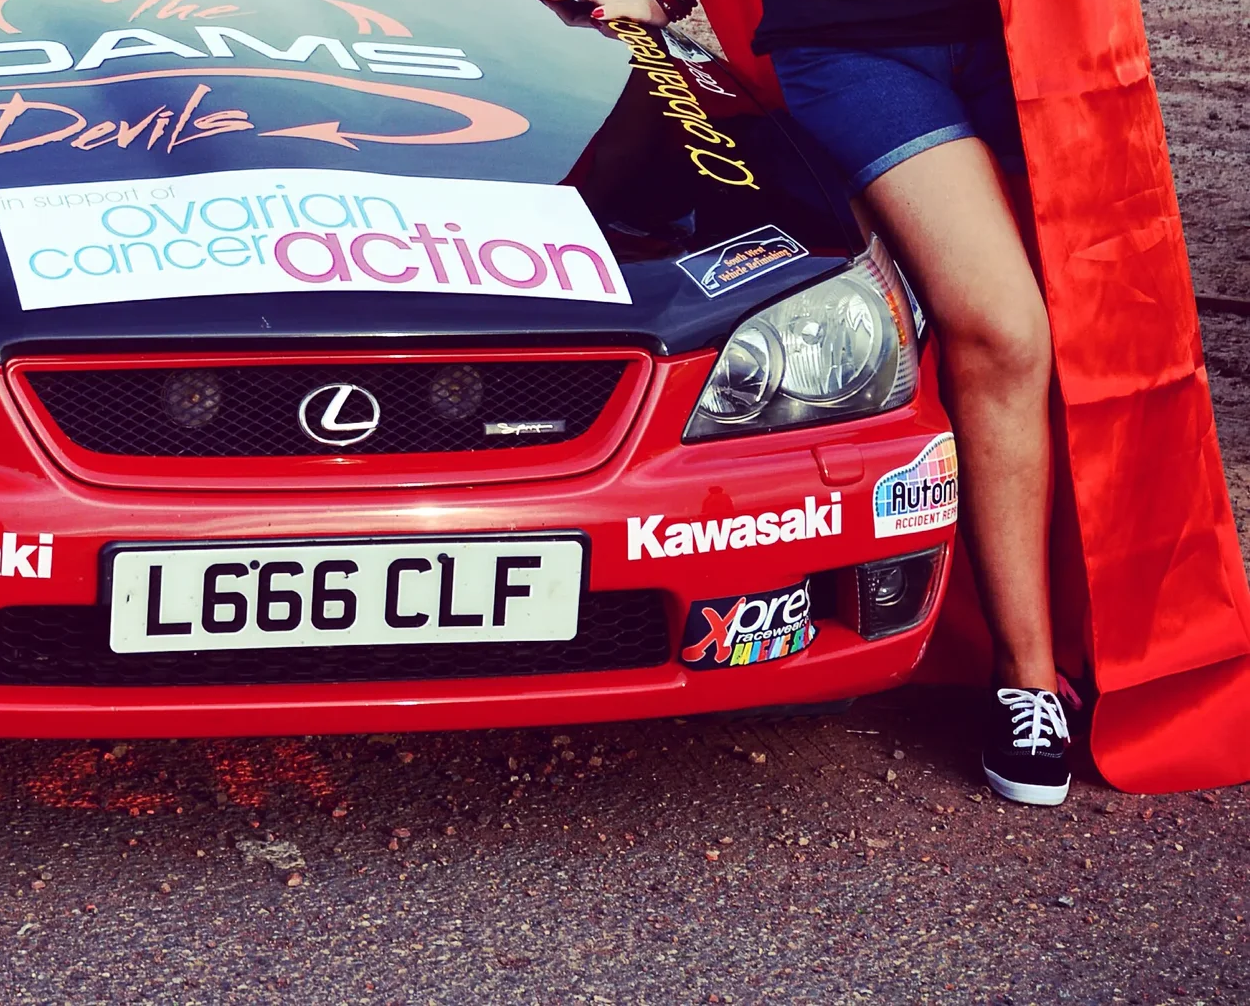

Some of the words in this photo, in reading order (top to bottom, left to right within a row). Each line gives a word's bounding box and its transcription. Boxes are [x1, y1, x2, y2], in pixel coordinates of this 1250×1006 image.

[0, 194, 25, 211] in
[32, 185, 140, 210] support
[150, 184, 176, 200] of
[101, 184, 410, 238] ovarian
[717, 264, 749, 283] Vehicle
[745, 248, 793, 271] Refinishing
[723, 252, 750, 268] South
[627, 491, 842, 561] Kawasaki
[895, 512, 941, 530] ACCIDENT
[146, 559, 359, 636] L666
[384, 555, 543, 630] CLF
